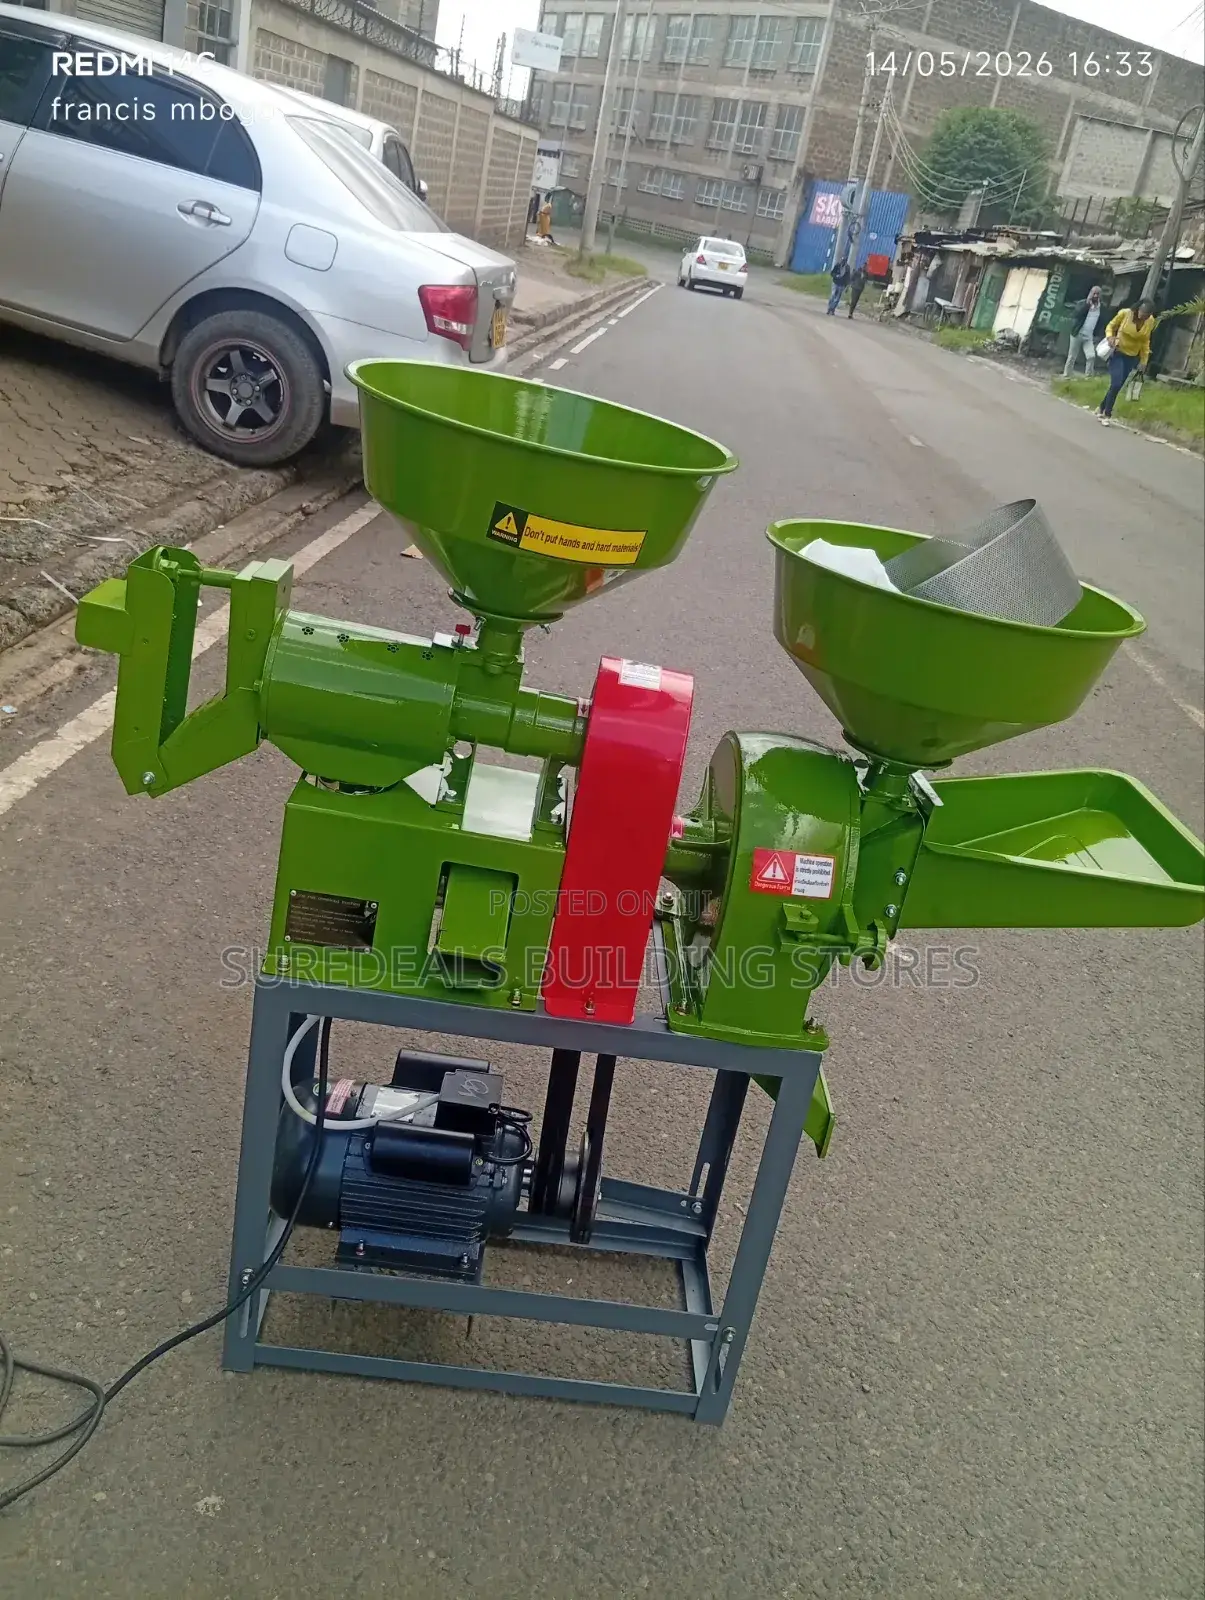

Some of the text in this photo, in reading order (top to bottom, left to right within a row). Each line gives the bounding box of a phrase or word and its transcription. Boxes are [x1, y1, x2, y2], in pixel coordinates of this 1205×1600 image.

[491, 529, 518, 543] WARNING
[524, 526, 545, 544] Don't
[545, 534, 558, 545] put
[558, 537, 580, 549] hands
[581, 541, 594, 551] and
[595, 542, 613, 552] hard
[754, 881, 776, 889] Dangerous
